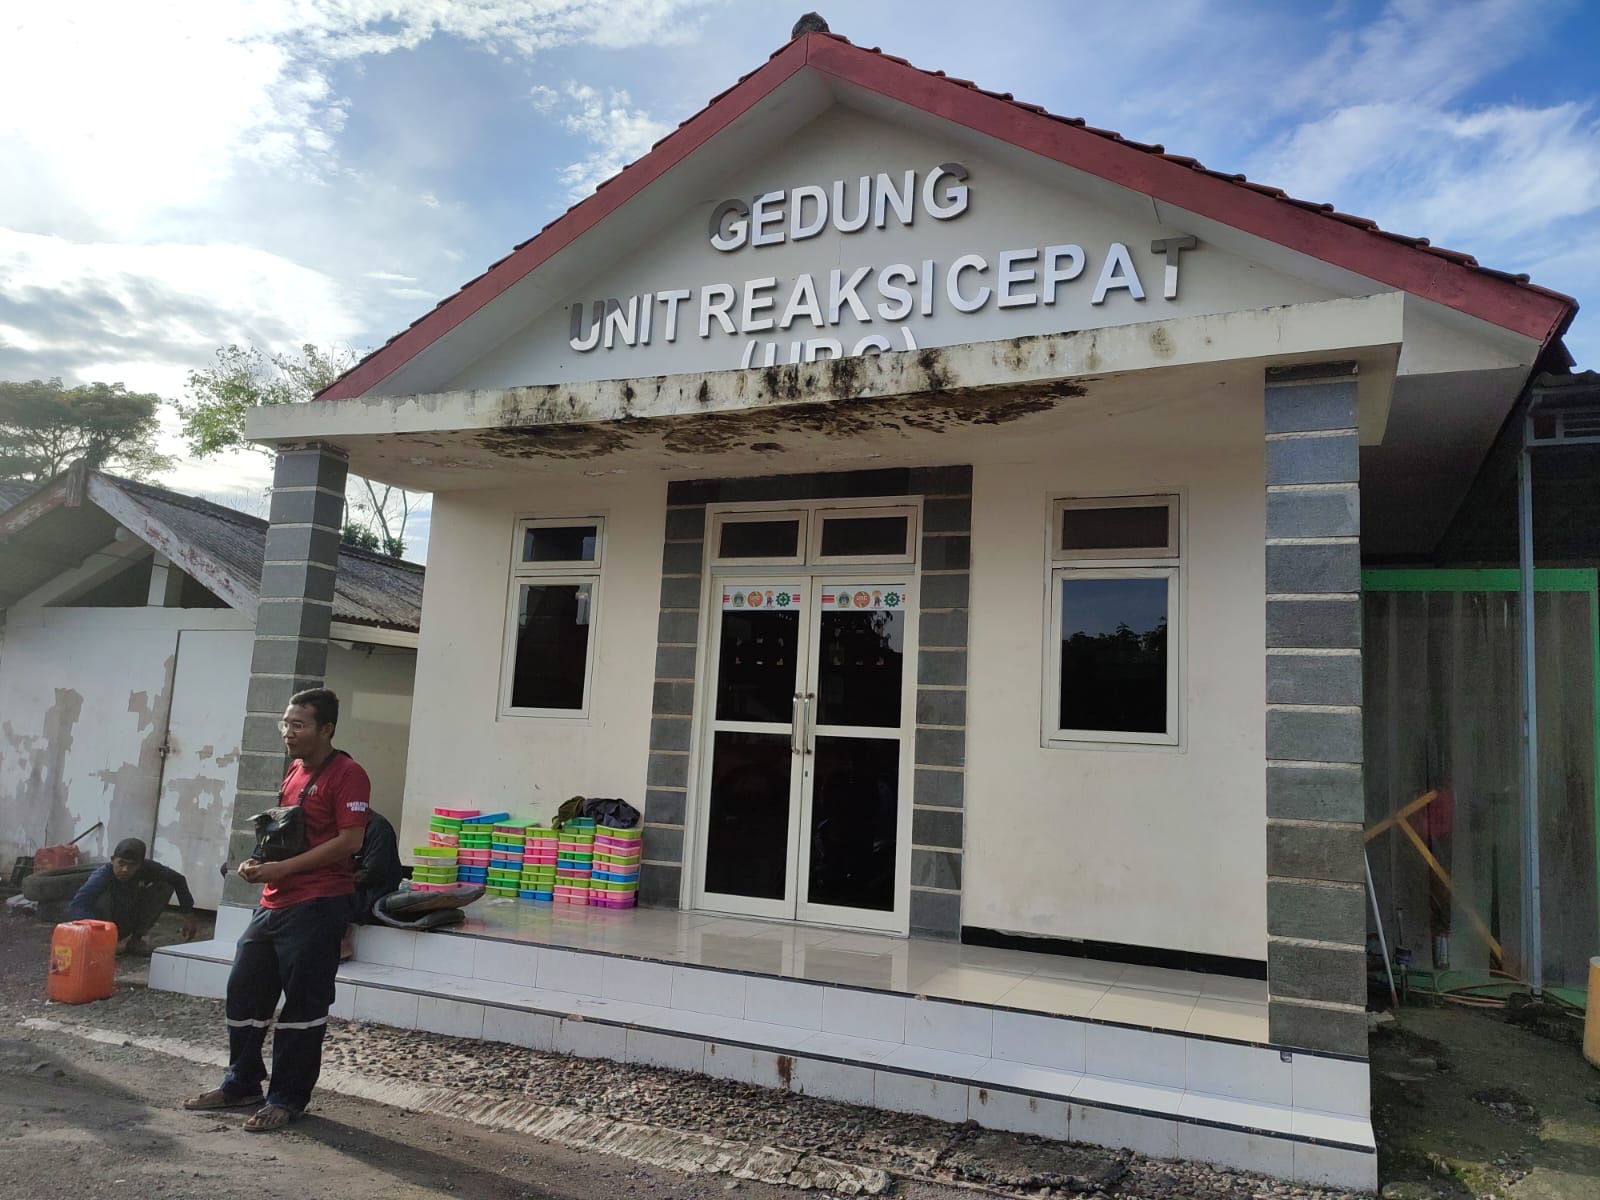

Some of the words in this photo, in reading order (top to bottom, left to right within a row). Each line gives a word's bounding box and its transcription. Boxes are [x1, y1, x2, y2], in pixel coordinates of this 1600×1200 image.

[709, 162, 969, 252] GEDUNG
[569, 289, 691, 352] UNIT
[699, 259, 935, 338] REAKSI
[946, 235, 1197, 313] CEPAT
